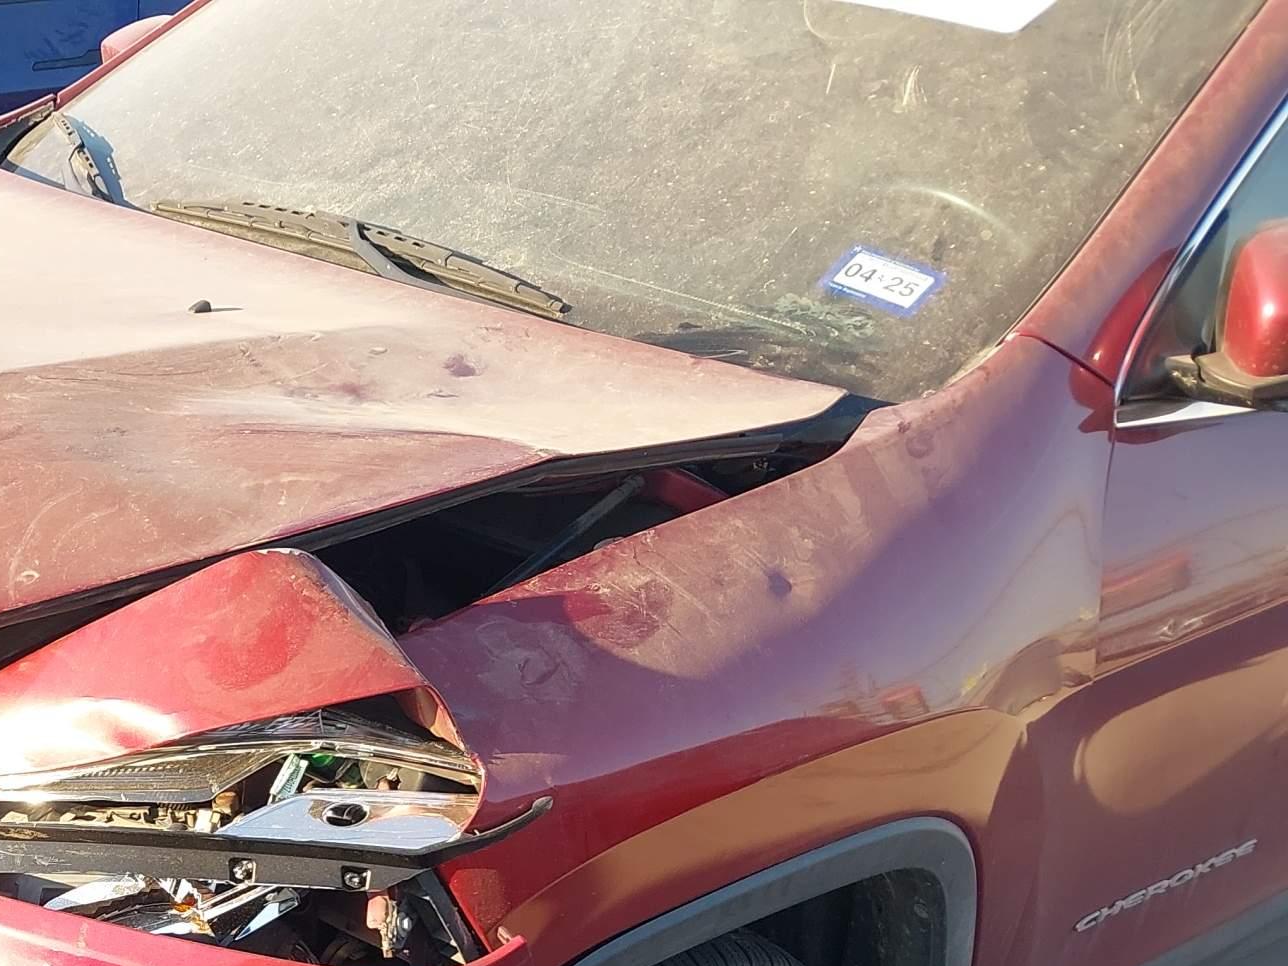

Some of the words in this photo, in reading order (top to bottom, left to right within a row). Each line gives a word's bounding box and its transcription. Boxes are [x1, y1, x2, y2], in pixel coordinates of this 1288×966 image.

[843, 262, 878, 283] 04
[882, 276, 920, 297] 25
[1073, 838, 1258, 932] CHEROKEE
